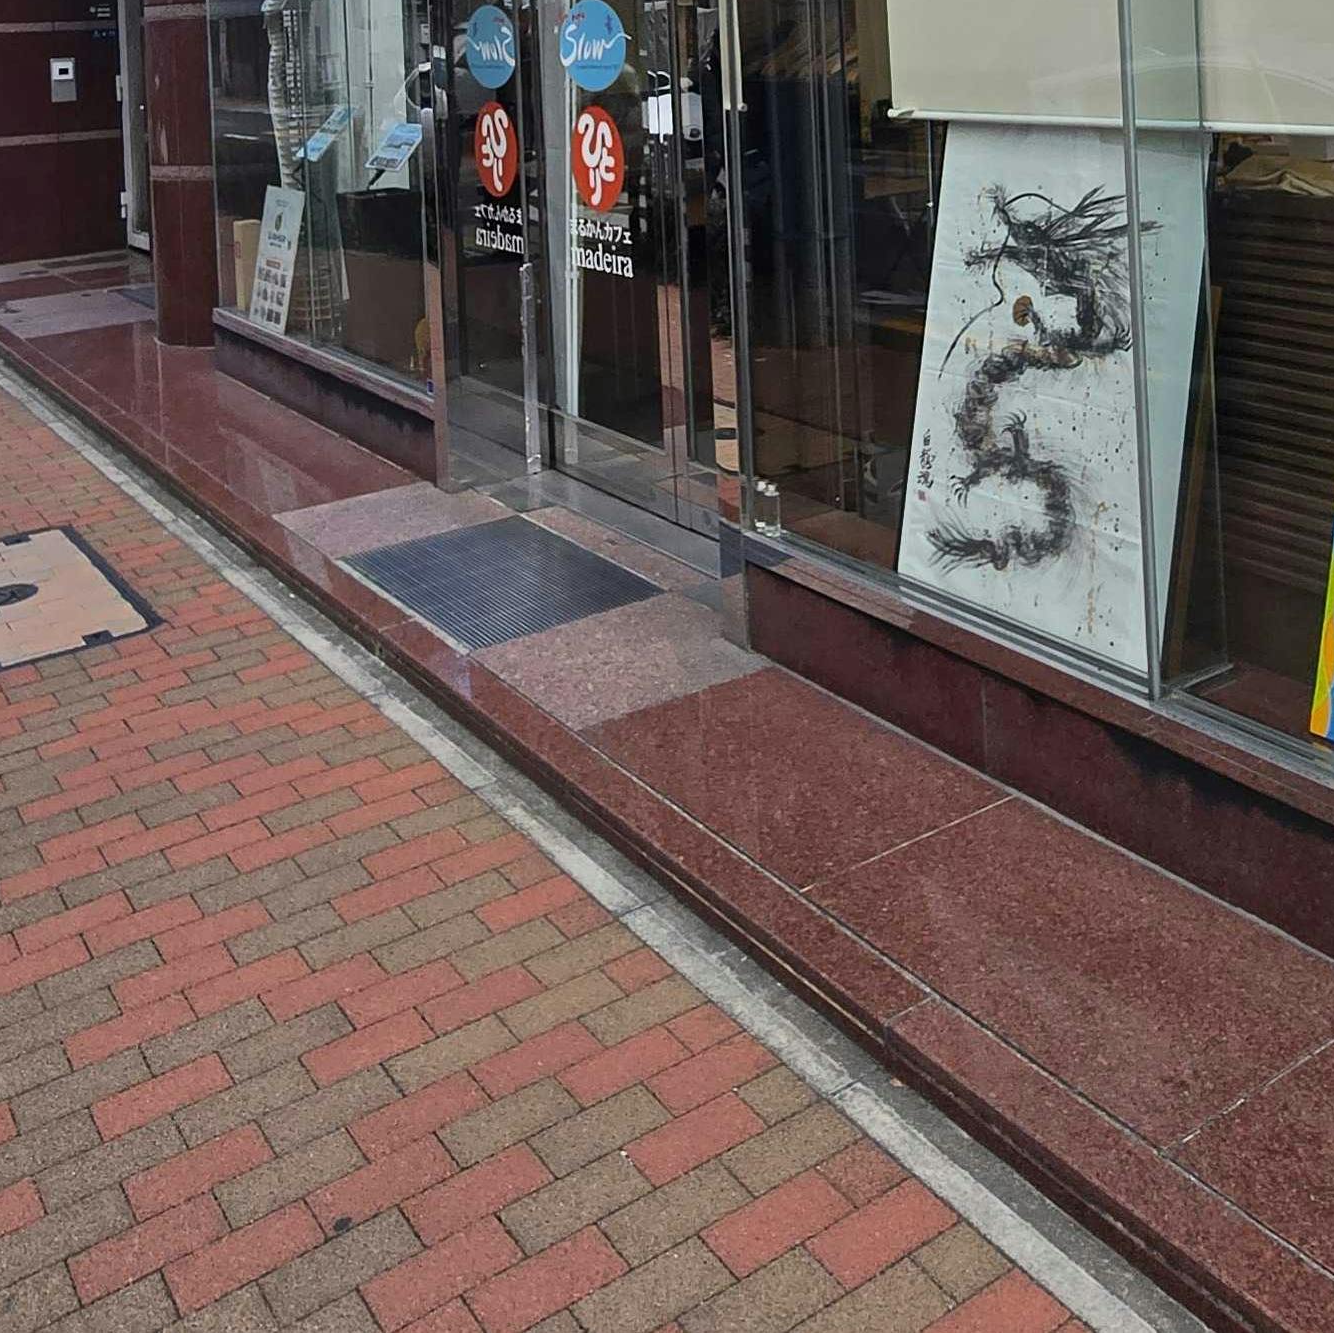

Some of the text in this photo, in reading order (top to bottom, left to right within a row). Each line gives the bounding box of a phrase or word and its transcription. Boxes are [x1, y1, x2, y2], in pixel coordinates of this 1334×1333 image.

[560, 24, 631, 67] Slow
[569, 218, 633, 245] まるかんカフェ
[571, 243, 634, 279] madeira
